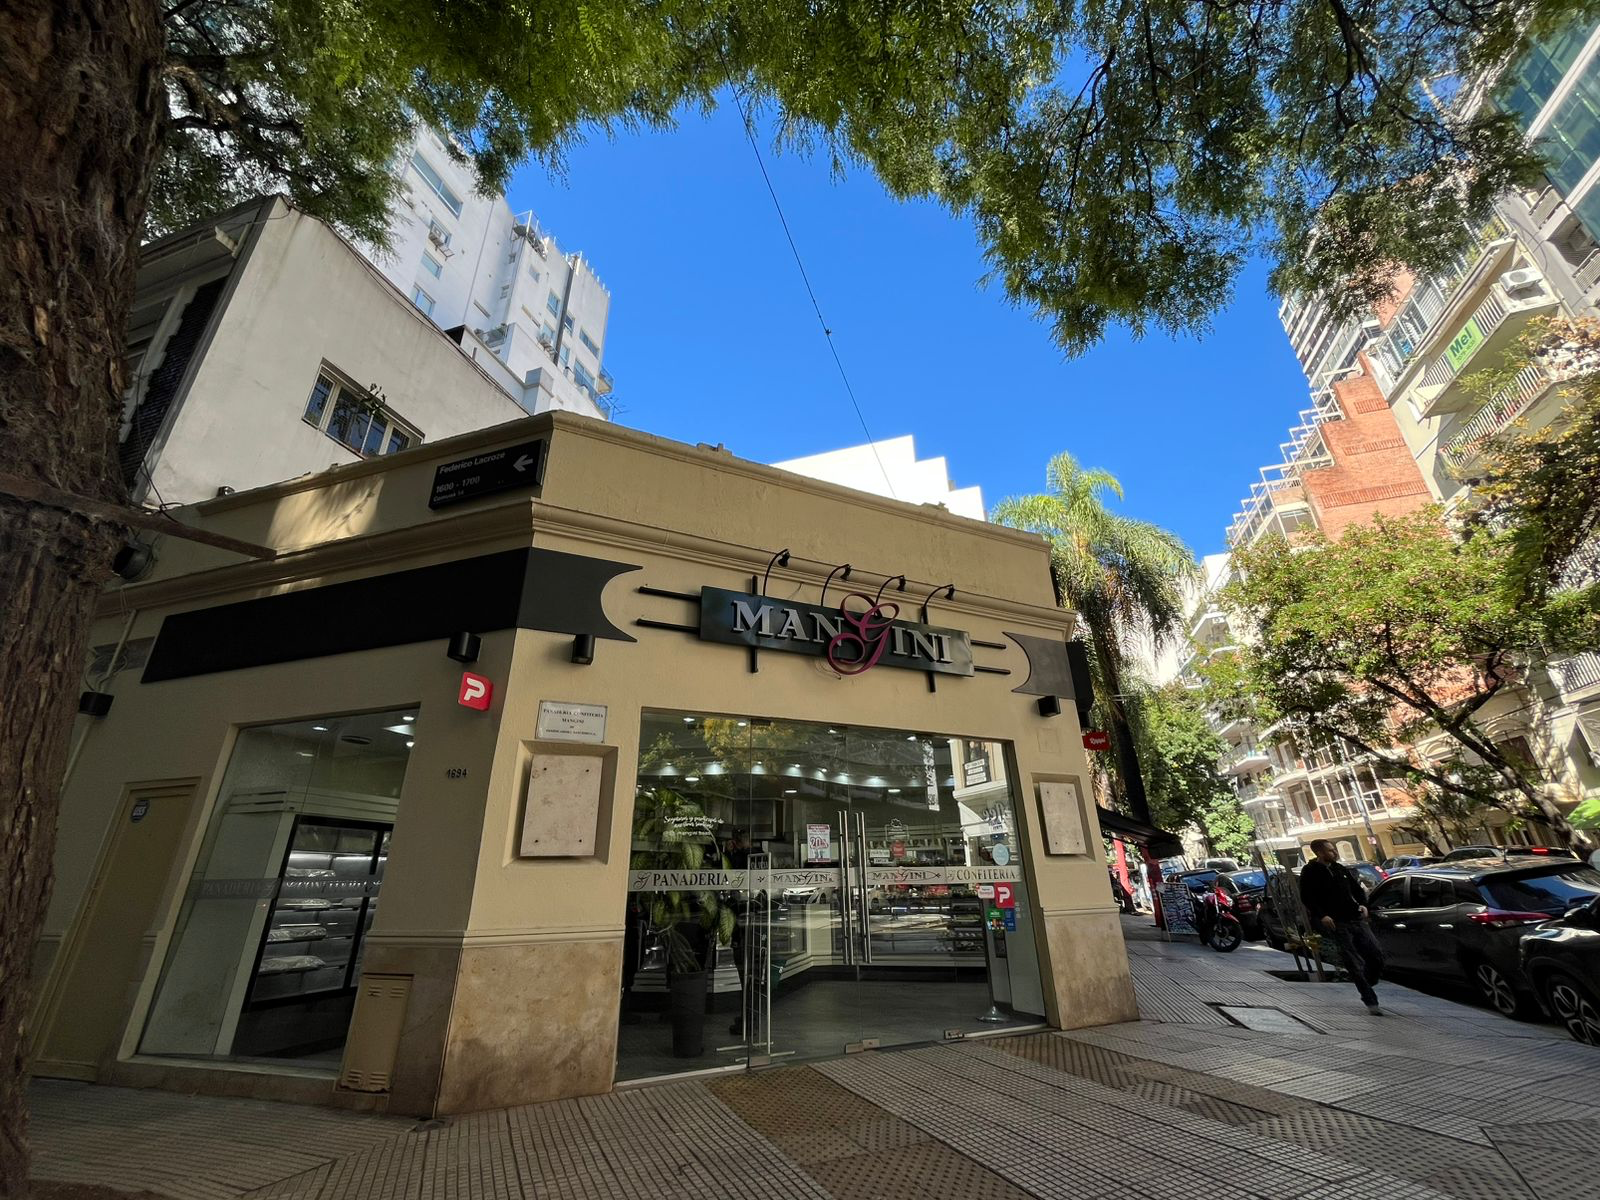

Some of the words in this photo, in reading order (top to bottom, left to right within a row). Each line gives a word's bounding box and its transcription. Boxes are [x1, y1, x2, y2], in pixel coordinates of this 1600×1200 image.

[439, 460, 473, 475] Federico
[474, 452, 506, 465] Lacroze
[436, 482, 454, 494] 1600
[462, 475, 481, 487] 1700
[731, 592, 953, 675] MANGINI
[446, 768, 467, 779] 1694
[653, 872, 729, 887] PANADERIA
[872, 867, 927, 882] MANGINI
[956, 865, 1016, 881] CONFITERIA
